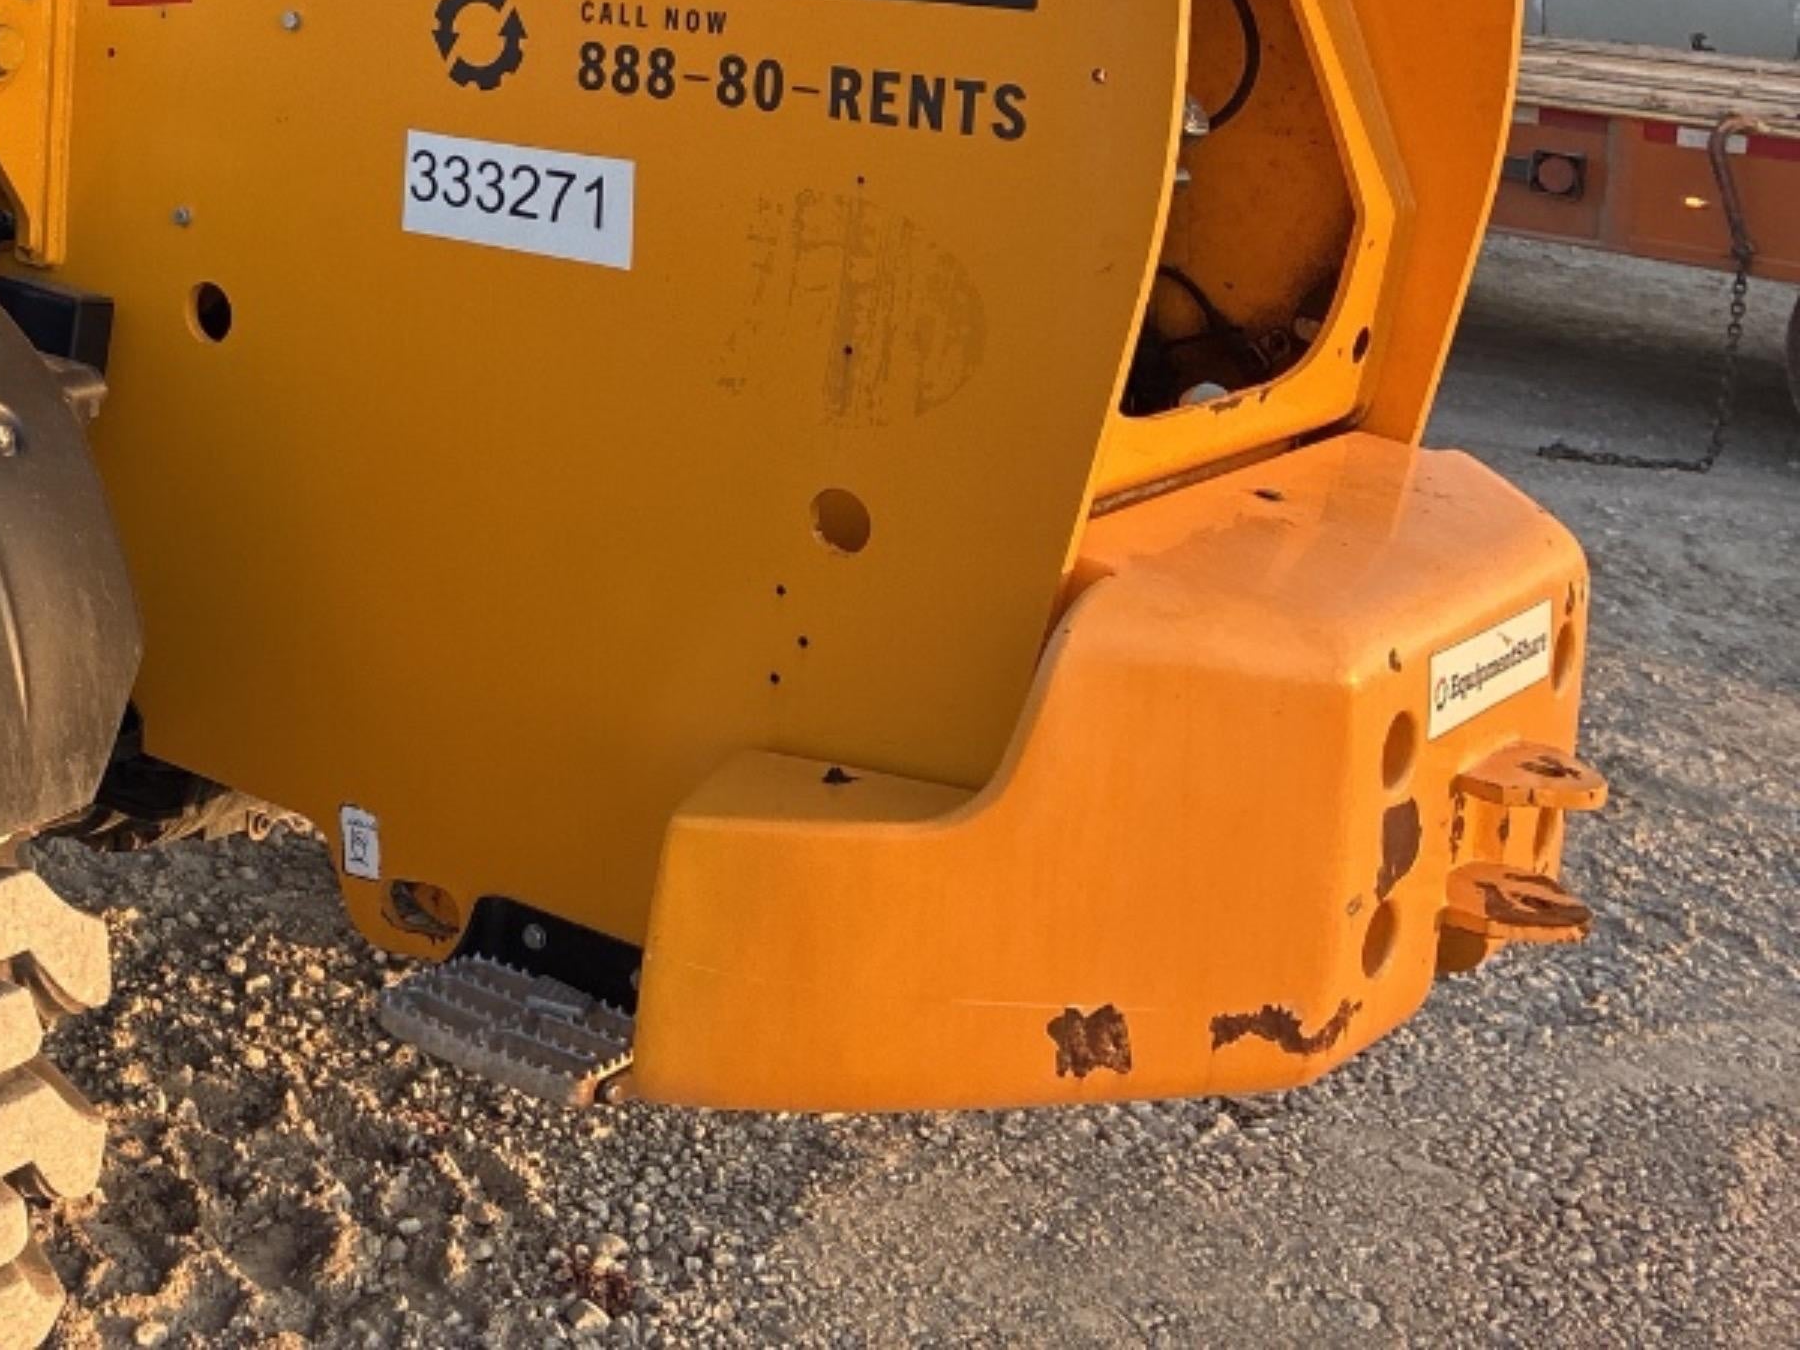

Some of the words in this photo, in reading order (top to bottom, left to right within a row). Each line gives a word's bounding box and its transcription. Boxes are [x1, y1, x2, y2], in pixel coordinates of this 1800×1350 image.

[580, 0, 649, 29] CALL
[664, 6, 728, 34] NOW
[577, 41, 1028, 141] 888-80-RENTS
[409, 149, 605, 230] 333271
